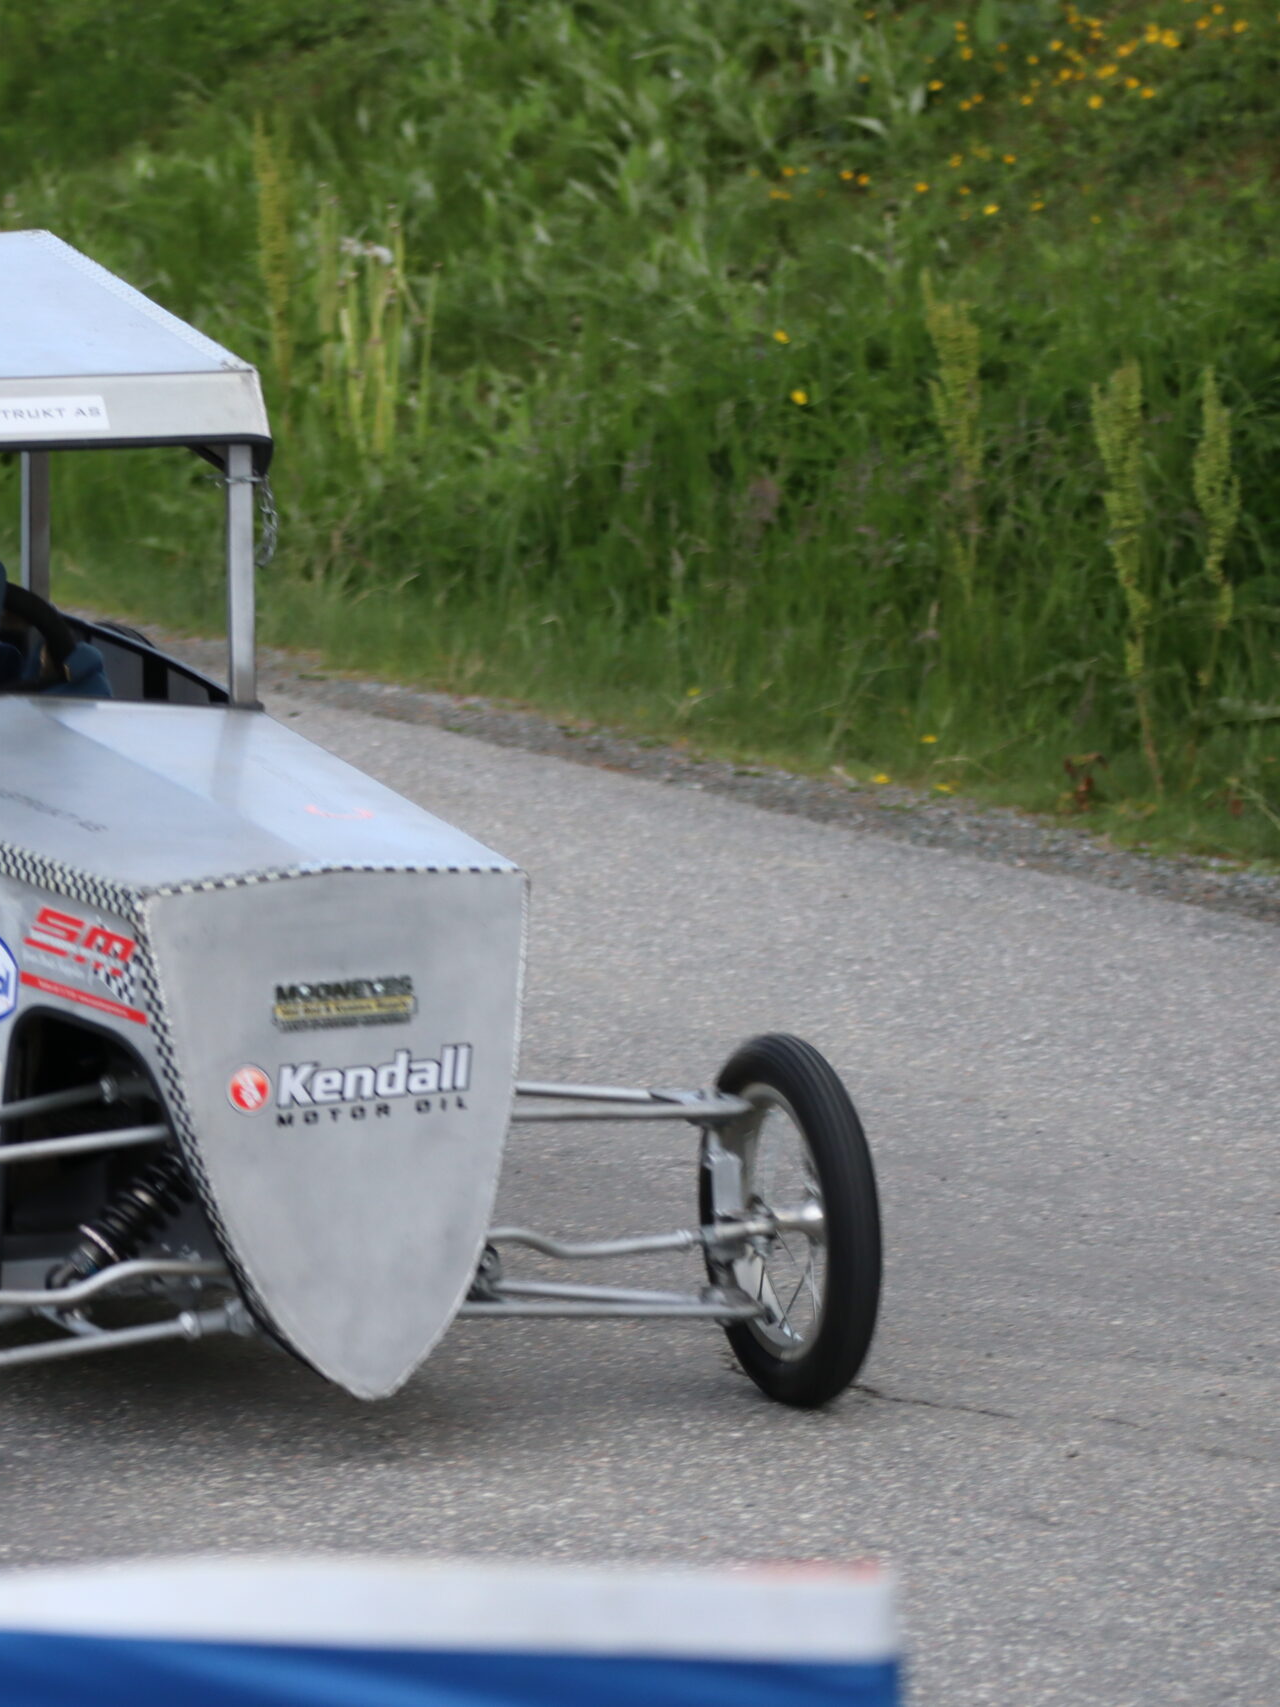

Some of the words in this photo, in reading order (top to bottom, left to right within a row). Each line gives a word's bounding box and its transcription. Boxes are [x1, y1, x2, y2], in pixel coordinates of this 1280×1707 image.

[74, 406, 101, 418] AS
[277, 1043, 471, 1107] Kendall
[276, 1103, 391, 1128] MOTOR
[415, 1096, 468, 1115] OIL
